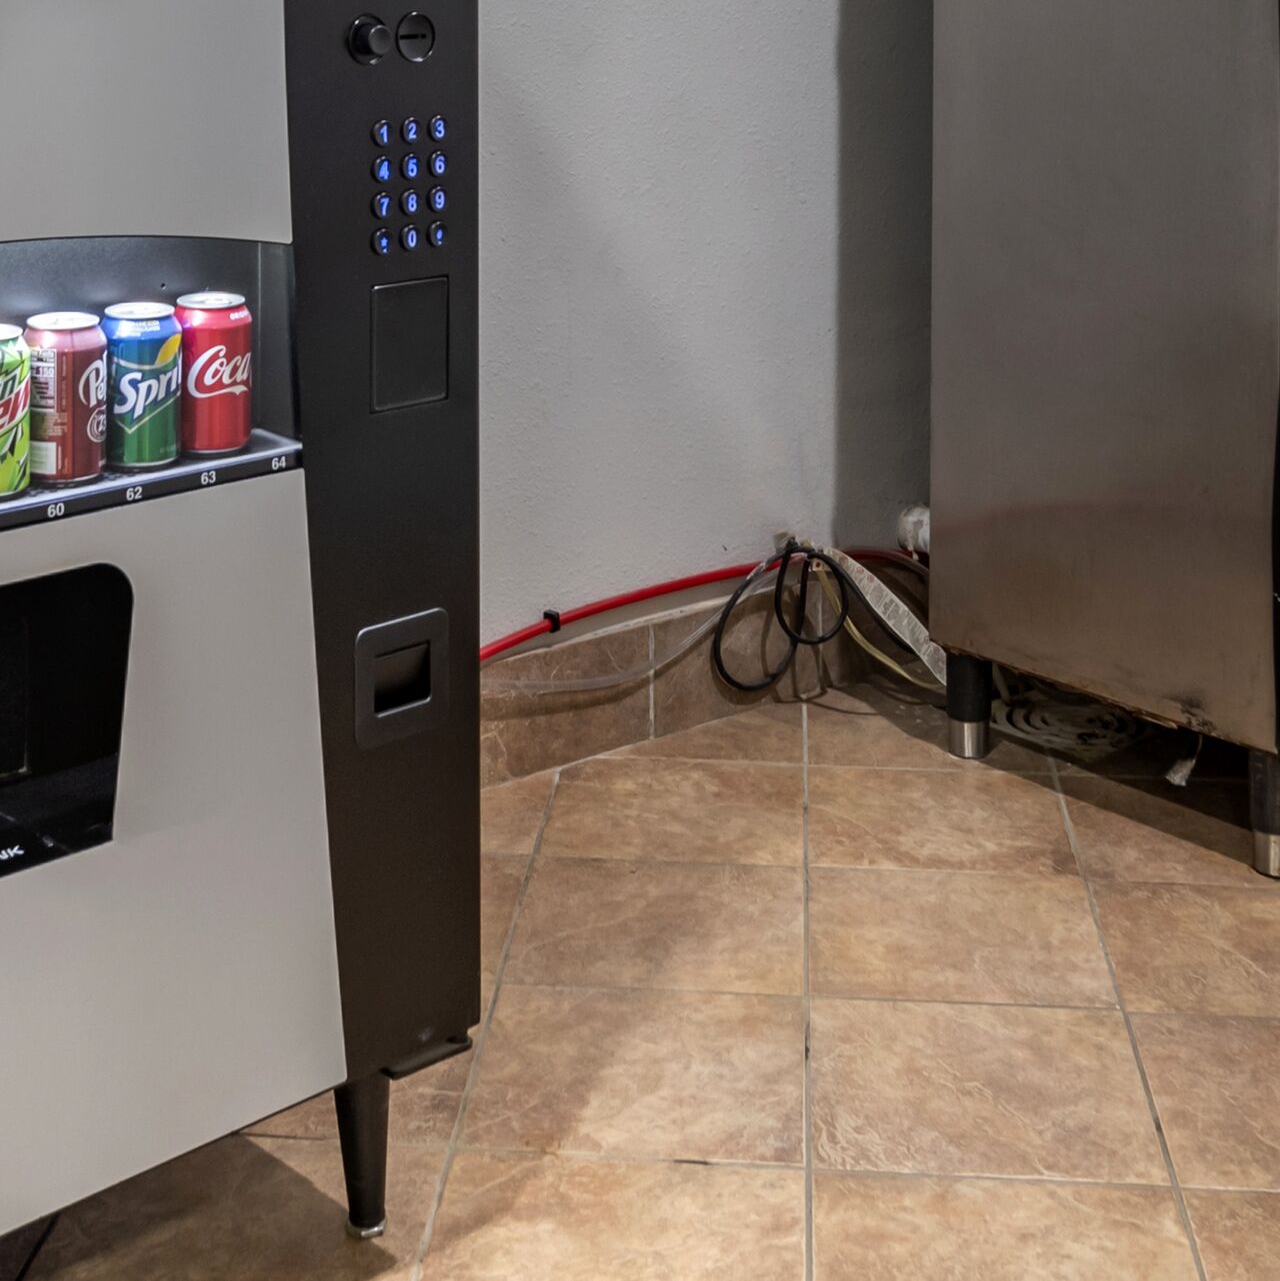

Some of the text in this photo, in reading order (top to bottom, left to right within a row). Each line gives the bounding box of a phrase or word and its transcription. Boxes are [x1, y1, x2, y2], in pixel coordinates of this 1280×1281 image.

[380, 125, 388, 143] 1
[408, 123, 417, 139] 2
[435, 120, 445, 138] 3
[379, 161, 389, 180] 4
[408, 159, 418, 177] 5
[435, 156, 445, 174] 6
[380, 198, 389, 216] 7
[408, 194, 417, 212] 8
[435, 191, 445, 209] 9
[408, 230, 417, 248] 0
[187, 345, 251, 399] Coca
[271, 455, 287, 471] 64
[200, 470, 217, 486] 63
[126, 486, 143, 502] 62
[47, 502, 65, 518] 60
